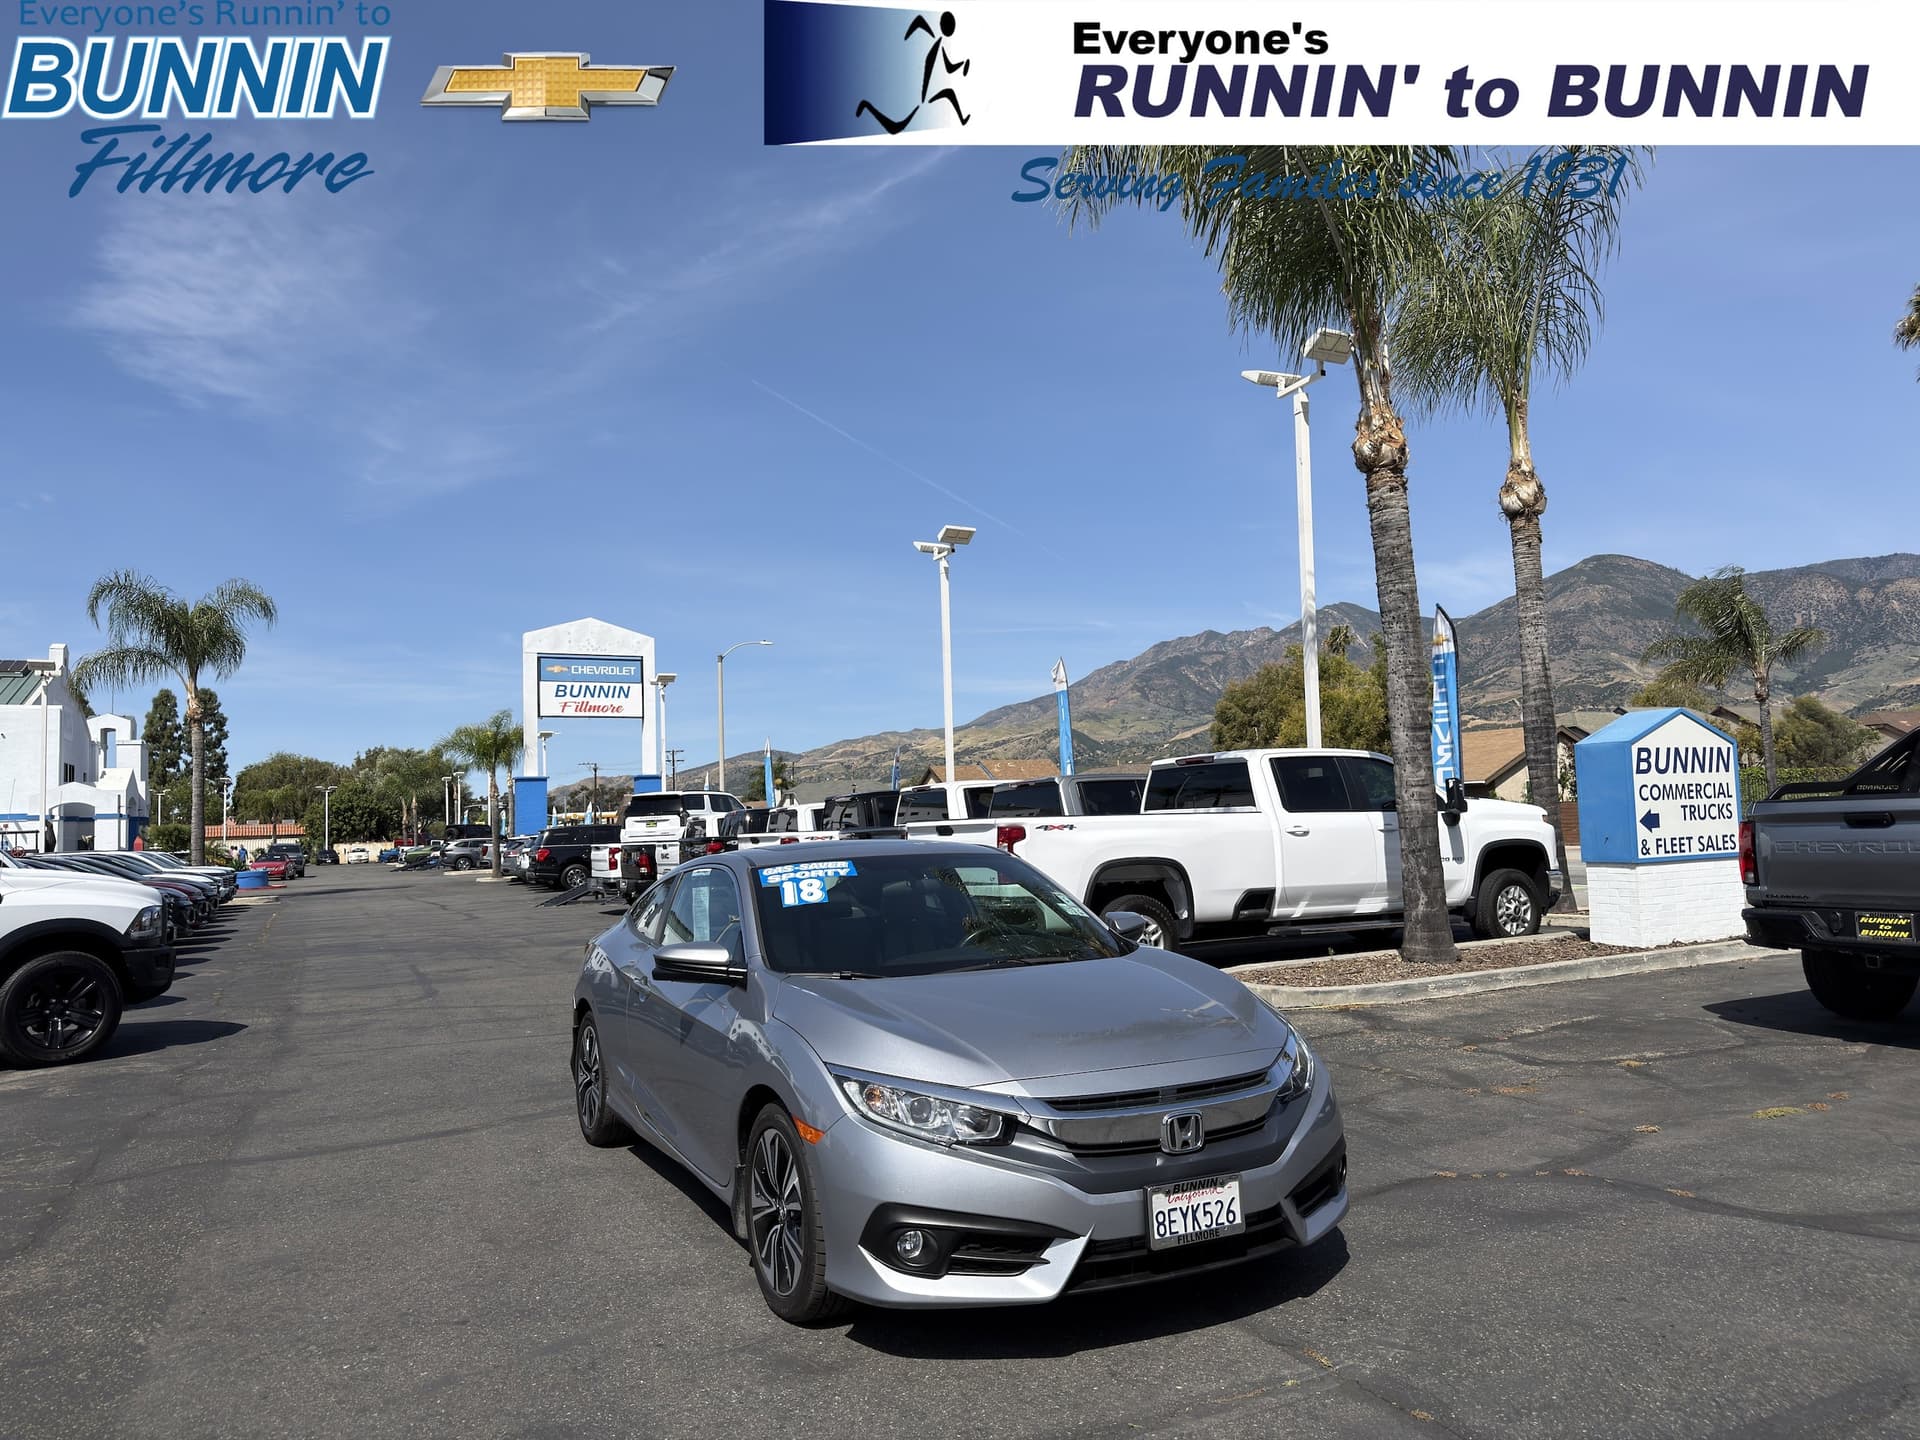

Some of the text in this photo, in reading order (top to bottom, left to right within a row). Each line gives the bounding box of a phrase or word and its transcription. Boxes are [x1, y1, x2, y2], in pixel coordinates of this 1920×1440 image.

[571, 665, 636, 676] CHEVROLET
[554, 684, 631, 699] BUNNIN
[559, 701, 624, 714] Fillmore
[1636, 746, 1731, 775] BUNNIN
[1639, 782, 1733, 801] COMMERCIAL
[1681, 803, 1733, 821] TRUCKS
[1641, 834, 1737, 856] & FLEET SALES
[767, 868, 850, 884] SPORTY
[782, 878, 826, 905] 18
[1860, 929, 1910, 938] BUNNIN
[1172, 1177, 1220, 1194] BUNNIN
[1155, 1196, 1236, 1238] 8EYK526
[1177, 1229, 1220, 1245] FILLMORE
